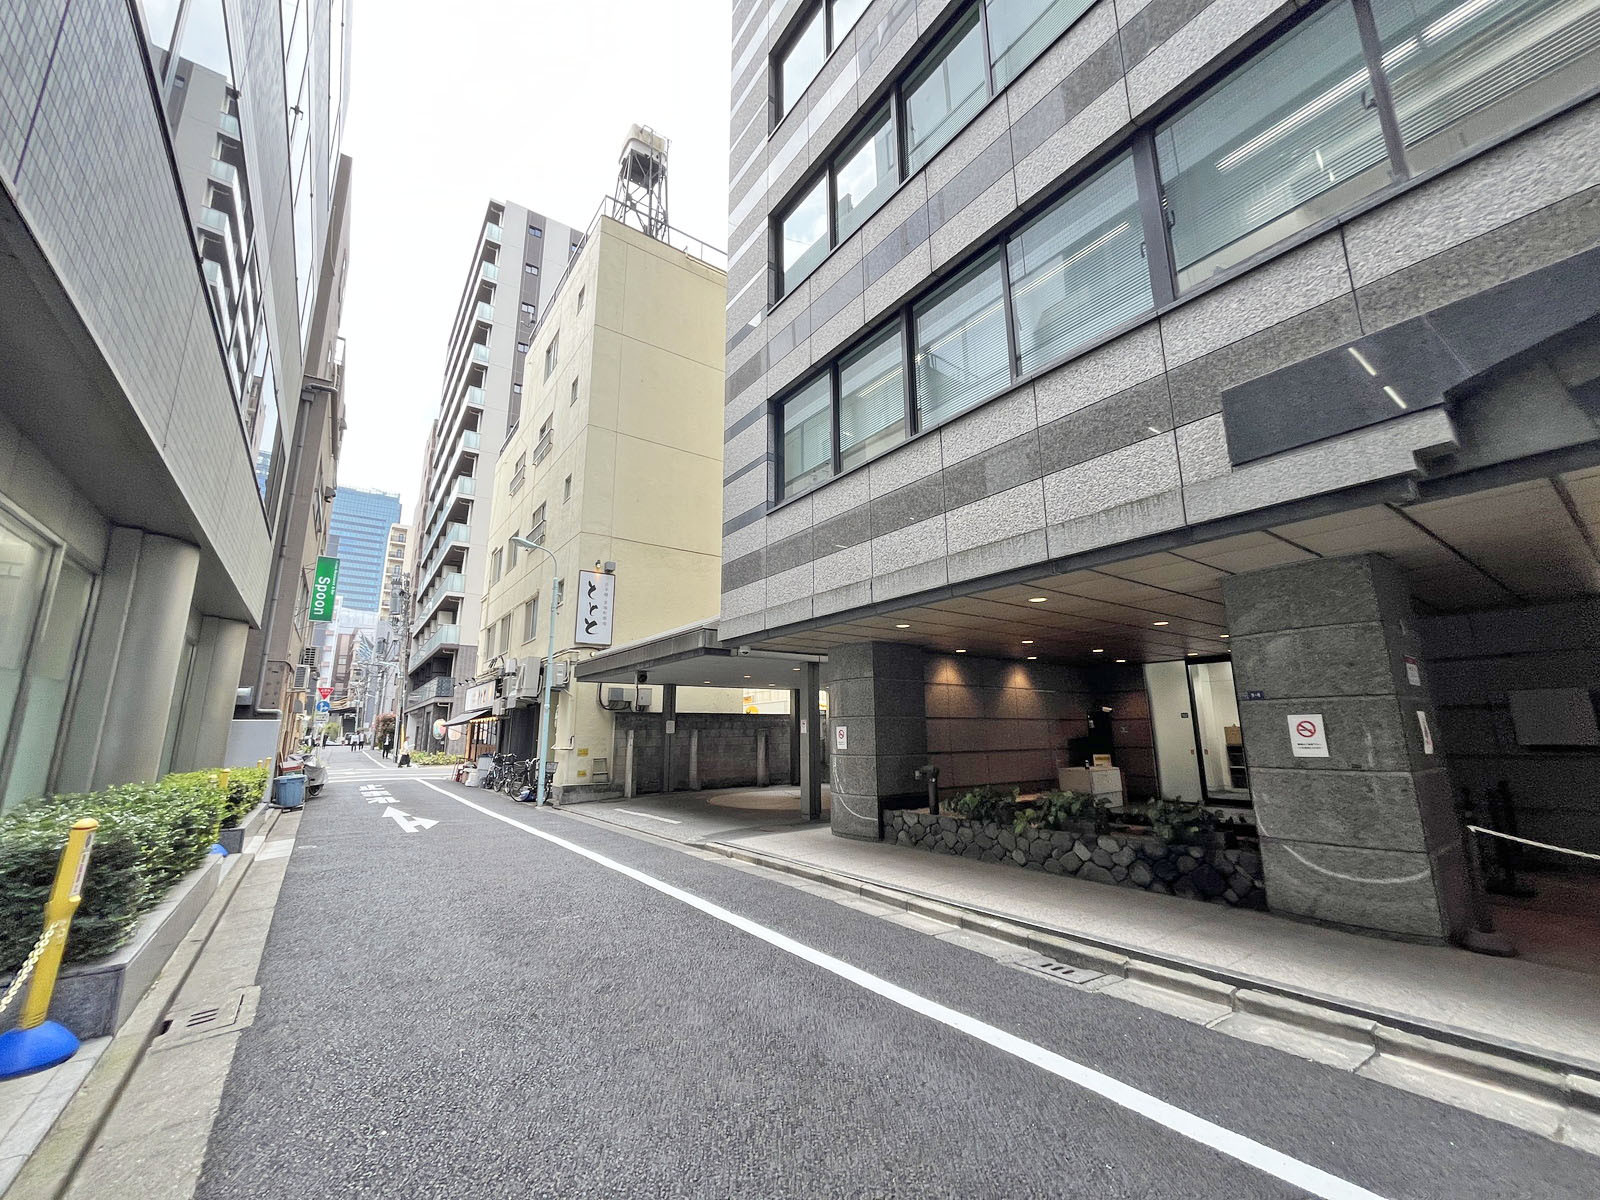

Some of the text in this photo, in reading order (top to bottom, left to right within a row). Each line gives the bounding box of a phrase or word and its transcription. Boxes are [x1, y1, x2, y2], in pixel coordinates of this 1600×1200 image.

[313, 576, 331, 615] Spoon
[584, 580, 599, 635] ととと
